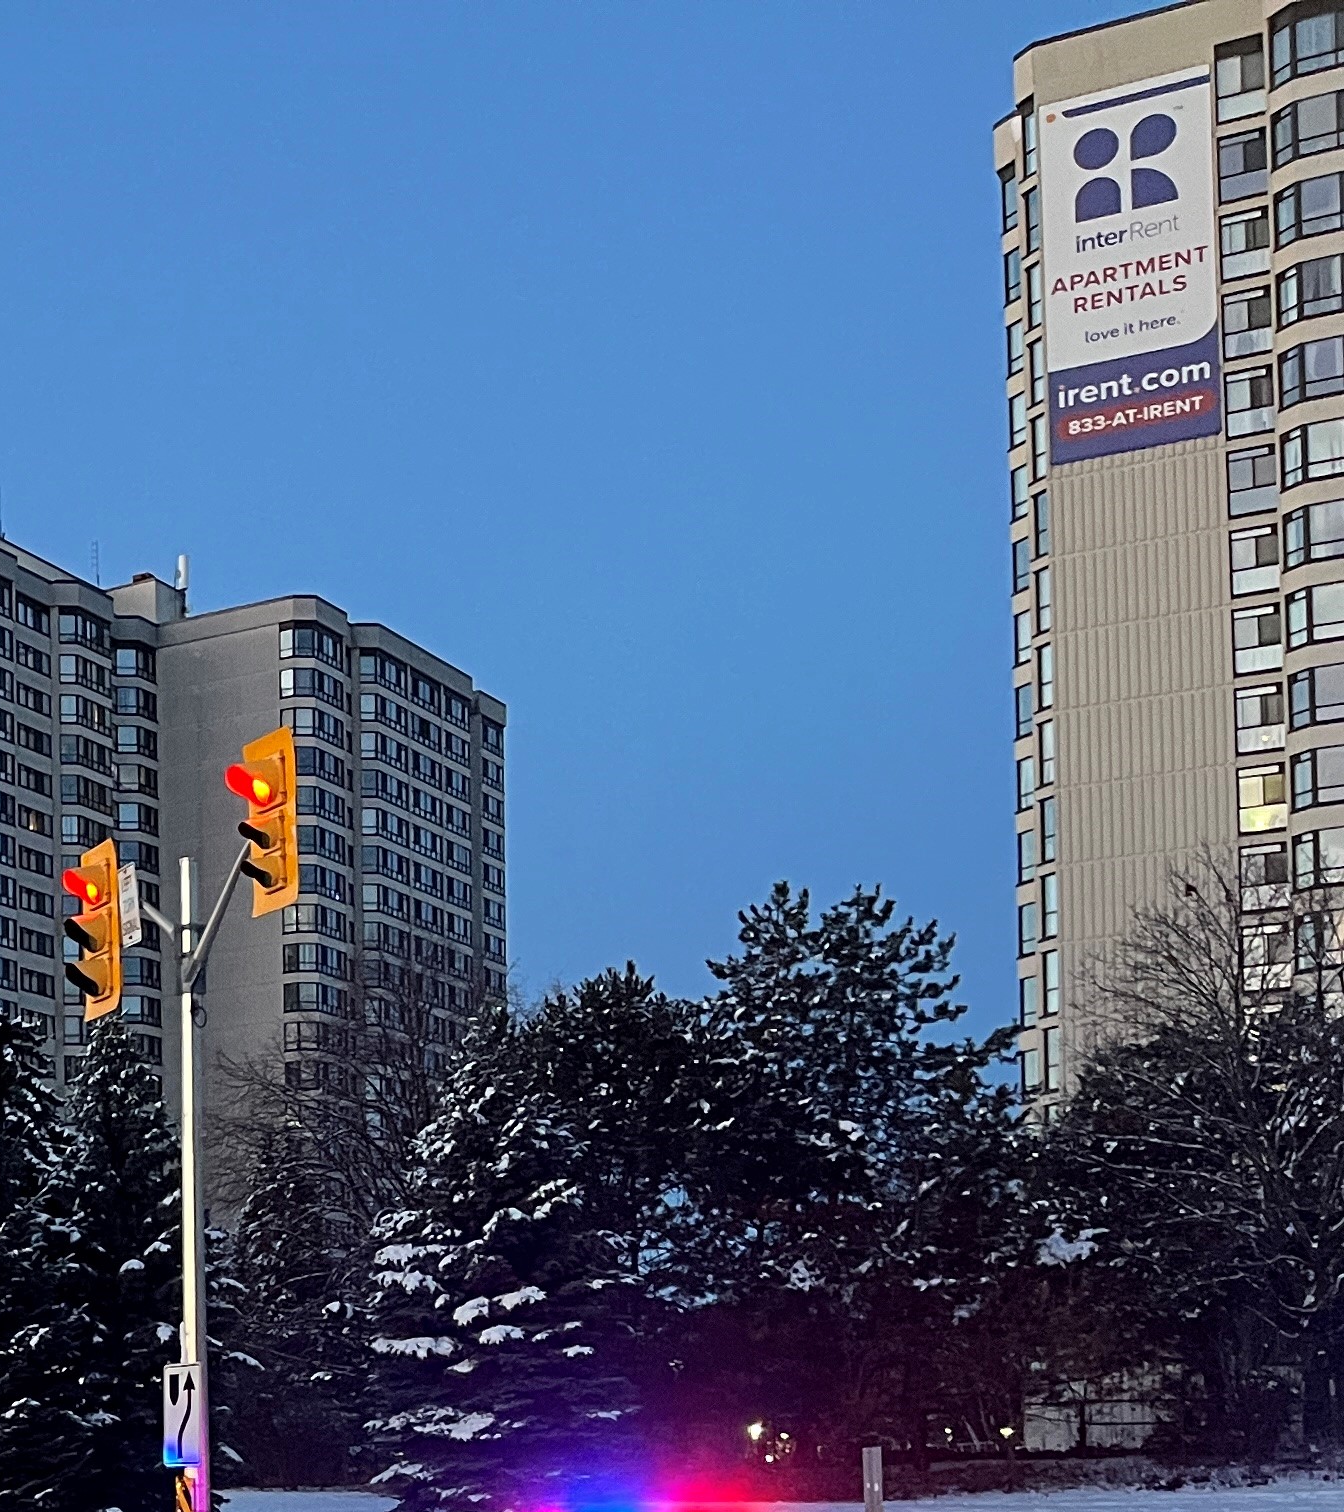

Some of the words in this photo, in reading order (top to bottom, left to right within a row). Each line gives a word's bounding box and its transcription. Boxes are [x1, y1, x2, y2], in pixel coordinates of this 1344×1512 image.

[1076, 215, 1180, 253] interRent
[1051, 245, 1208, 295] APARTMENT
[1074, 275, 1187, 313] RENTALS
[1085, 327, 1119, 343] love
[1124, 322, 1135, 335] it
[1058, 361, 1211, 408] irent.com
[1068, 395, 1203, 435] 833-AT-IRENT
